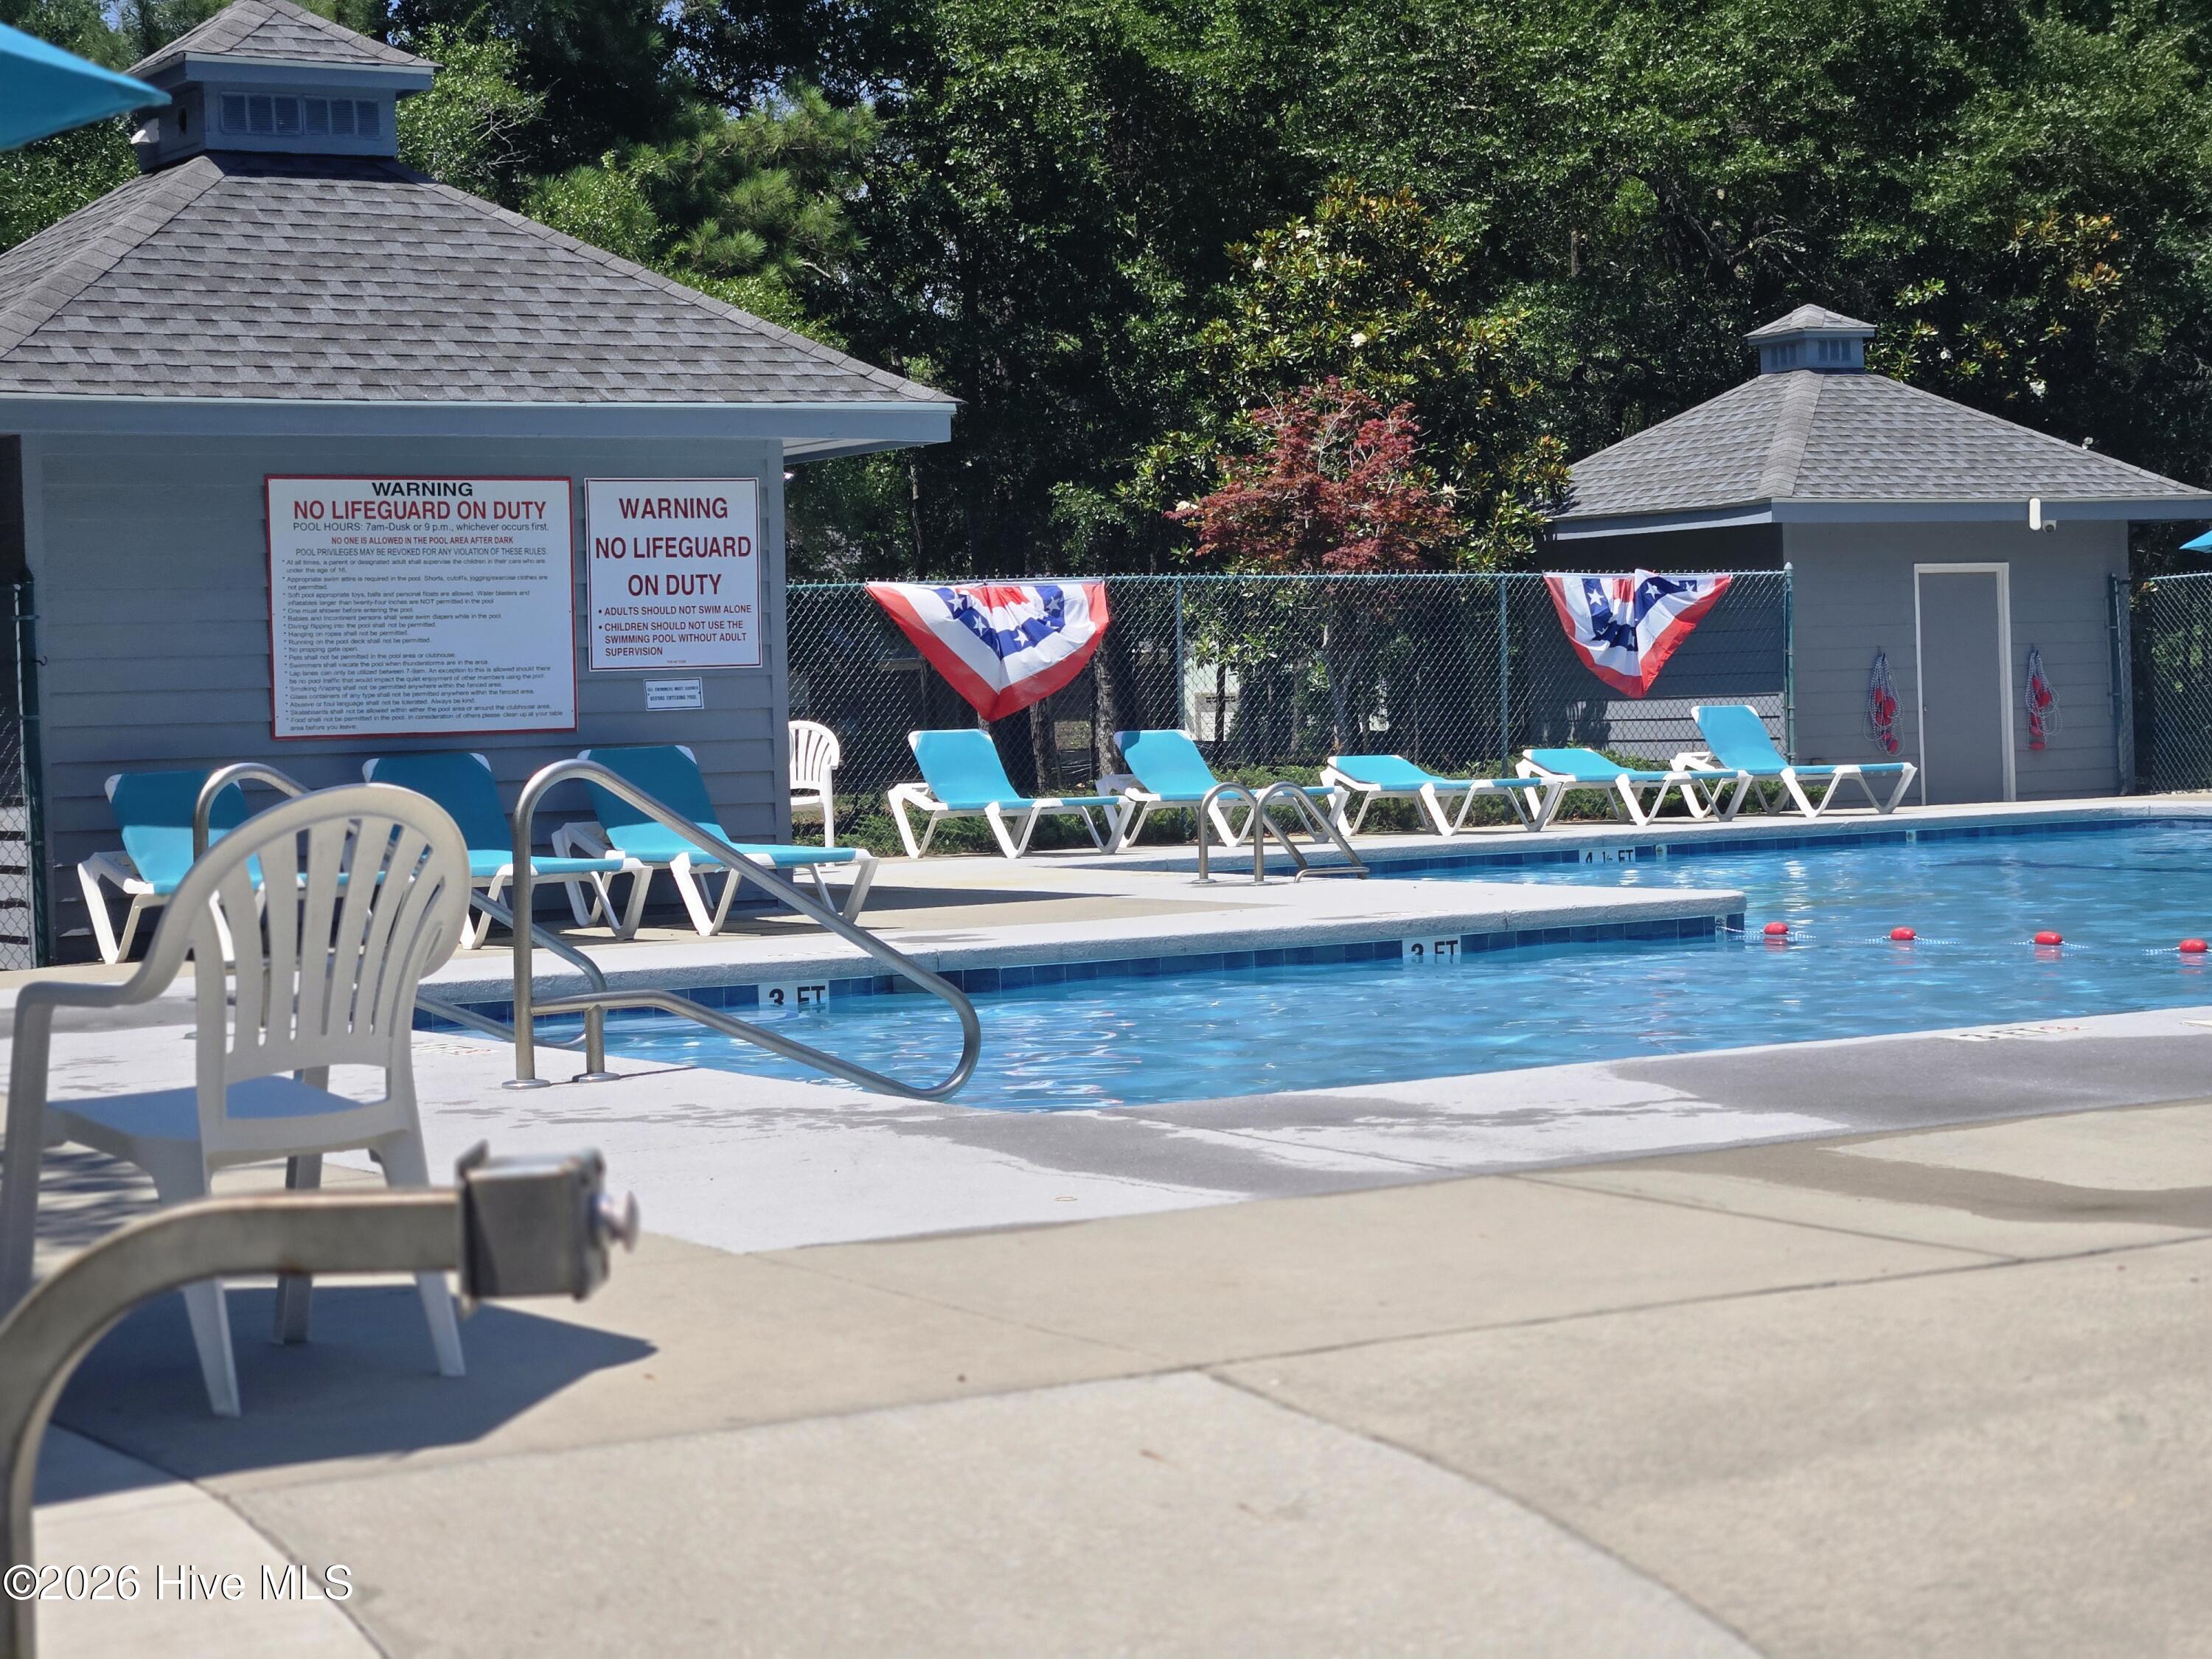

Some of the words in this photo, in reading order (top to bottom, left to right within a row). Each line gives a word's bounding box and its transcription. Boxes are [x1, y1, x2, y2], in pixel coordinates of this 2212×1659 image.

[372, 482, 473, 496] WARNING
[294, 501, 324, 519] NO
[332, 501, 451, 520] LIFEGUARD
[457, 501, 486, 519] ON
[493, 501, 546, 519] DUTY
[619, 498, 727, 518] WARNING
[293, 523, 321, 531] POOL
[324, 523, 364, 531] HOURS:
[366, 522, 410, 531] 7am-Dusk
[424, 523, 430, 531] 9
[456, 523, 499, 531] whichever
[532, 523, 549, 531] first.
[596, 538, 626, 559] NO
[634, 537, 751, 558] LIFEGUARD
[628, 574, 658, 596] ON
[667, 574, 721, 595] DUTY
[605, 608, 639, 616] ADULTS
[641, 606, 676, 615] SHOULD
[678, 606, 696, 614] NOT
[698, 605, 720, 614] SWIM
[723, 605, 751, 613] ALONE
[605, 622, 648, 631] CHILDREN
[651, 622, 686, 630] SHOULD
[689, 622, 706, 630] NOT
[708, 621, 724, 629] USE
[727, 621, 743, 629] THE
[605, 635, 650, 644] SWIMMING
[653, 634, 676, 643] POOL
[678, 633, 717, 642] WITHOUT
[719, 633, 746, 641] ADULT
[605, 647, 663, 656] SUPERVISION
[1618, 849, 1634, 863] FT
[1434, 939, 1458, 956] FT
[769, 988, 785, 1006] 3
[797, 985, 826, 1004] FT
